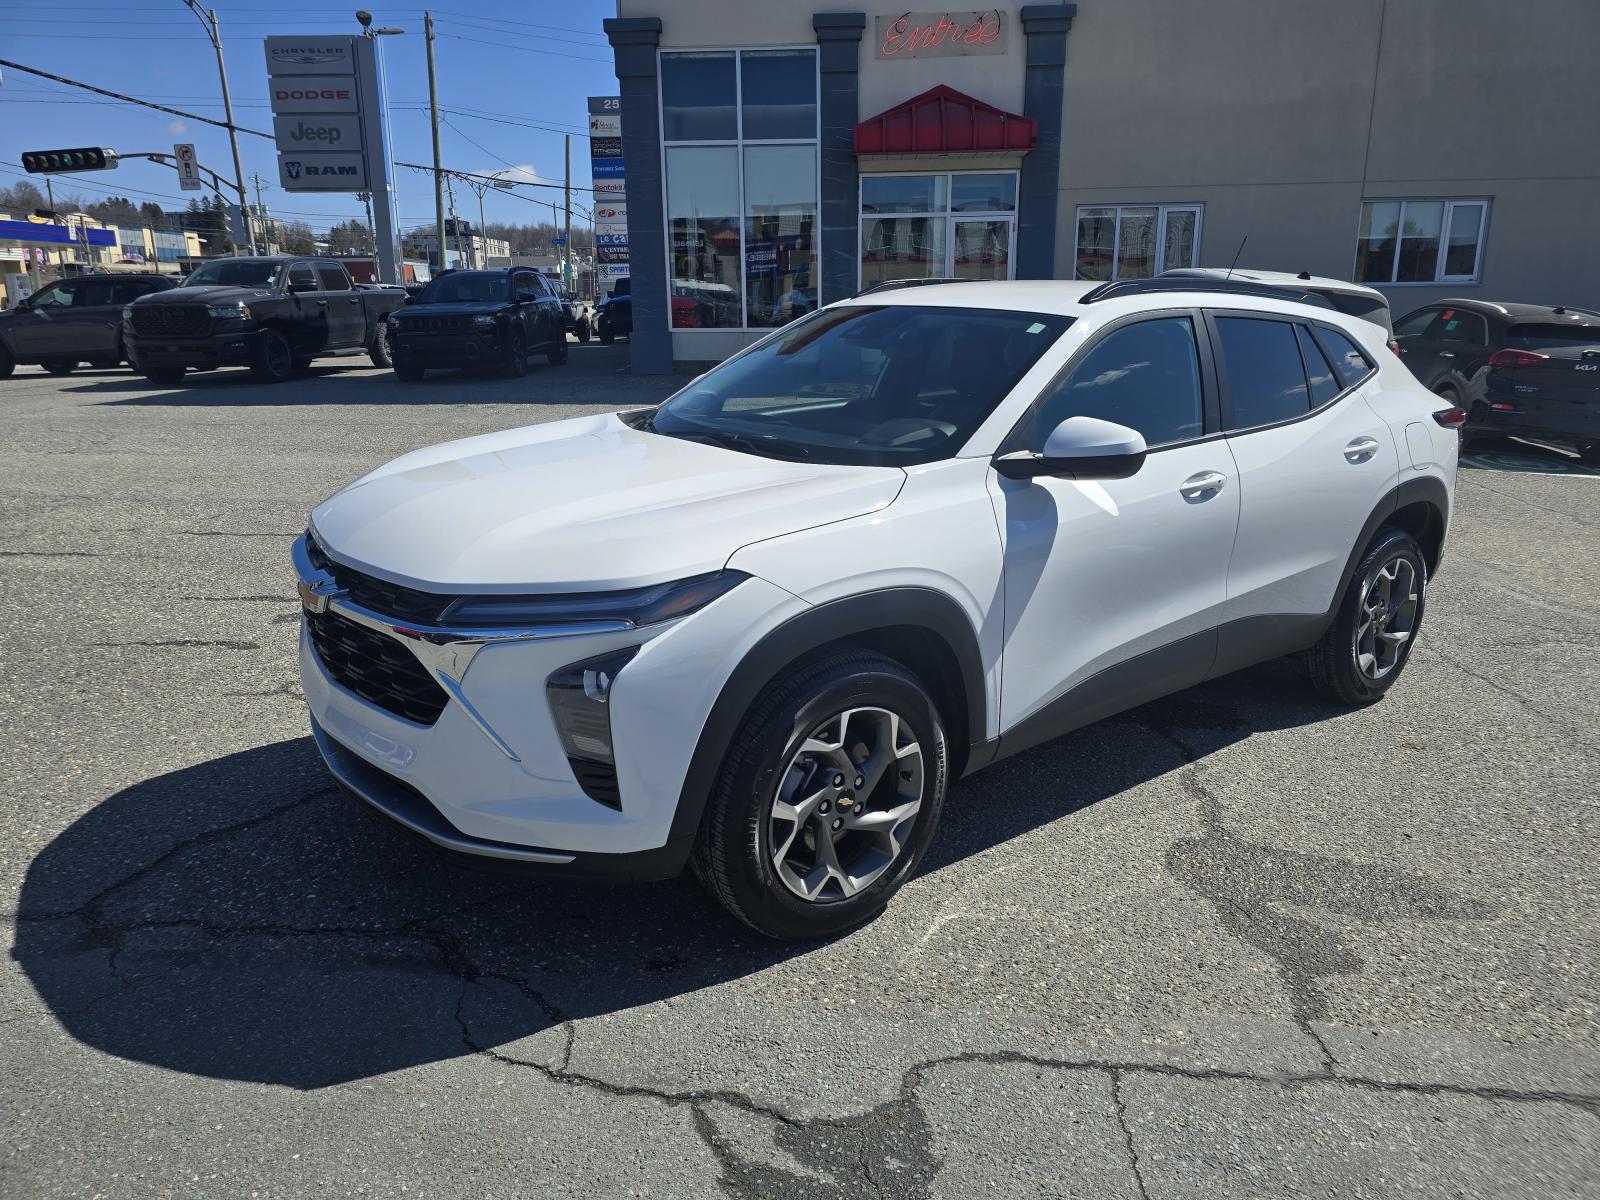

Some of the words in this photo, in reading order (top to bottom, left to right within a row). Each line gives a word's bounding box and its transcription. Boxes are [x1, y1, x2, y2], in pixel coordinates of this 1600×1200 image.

[272, 47, 344, 55] CHRYSLER
[275, 90, 350, 100] DODGE
[603, 99, 620, 109] 25
[290, 122, 341, 144] Jeep
[305, 166, 357, 176] RAM
